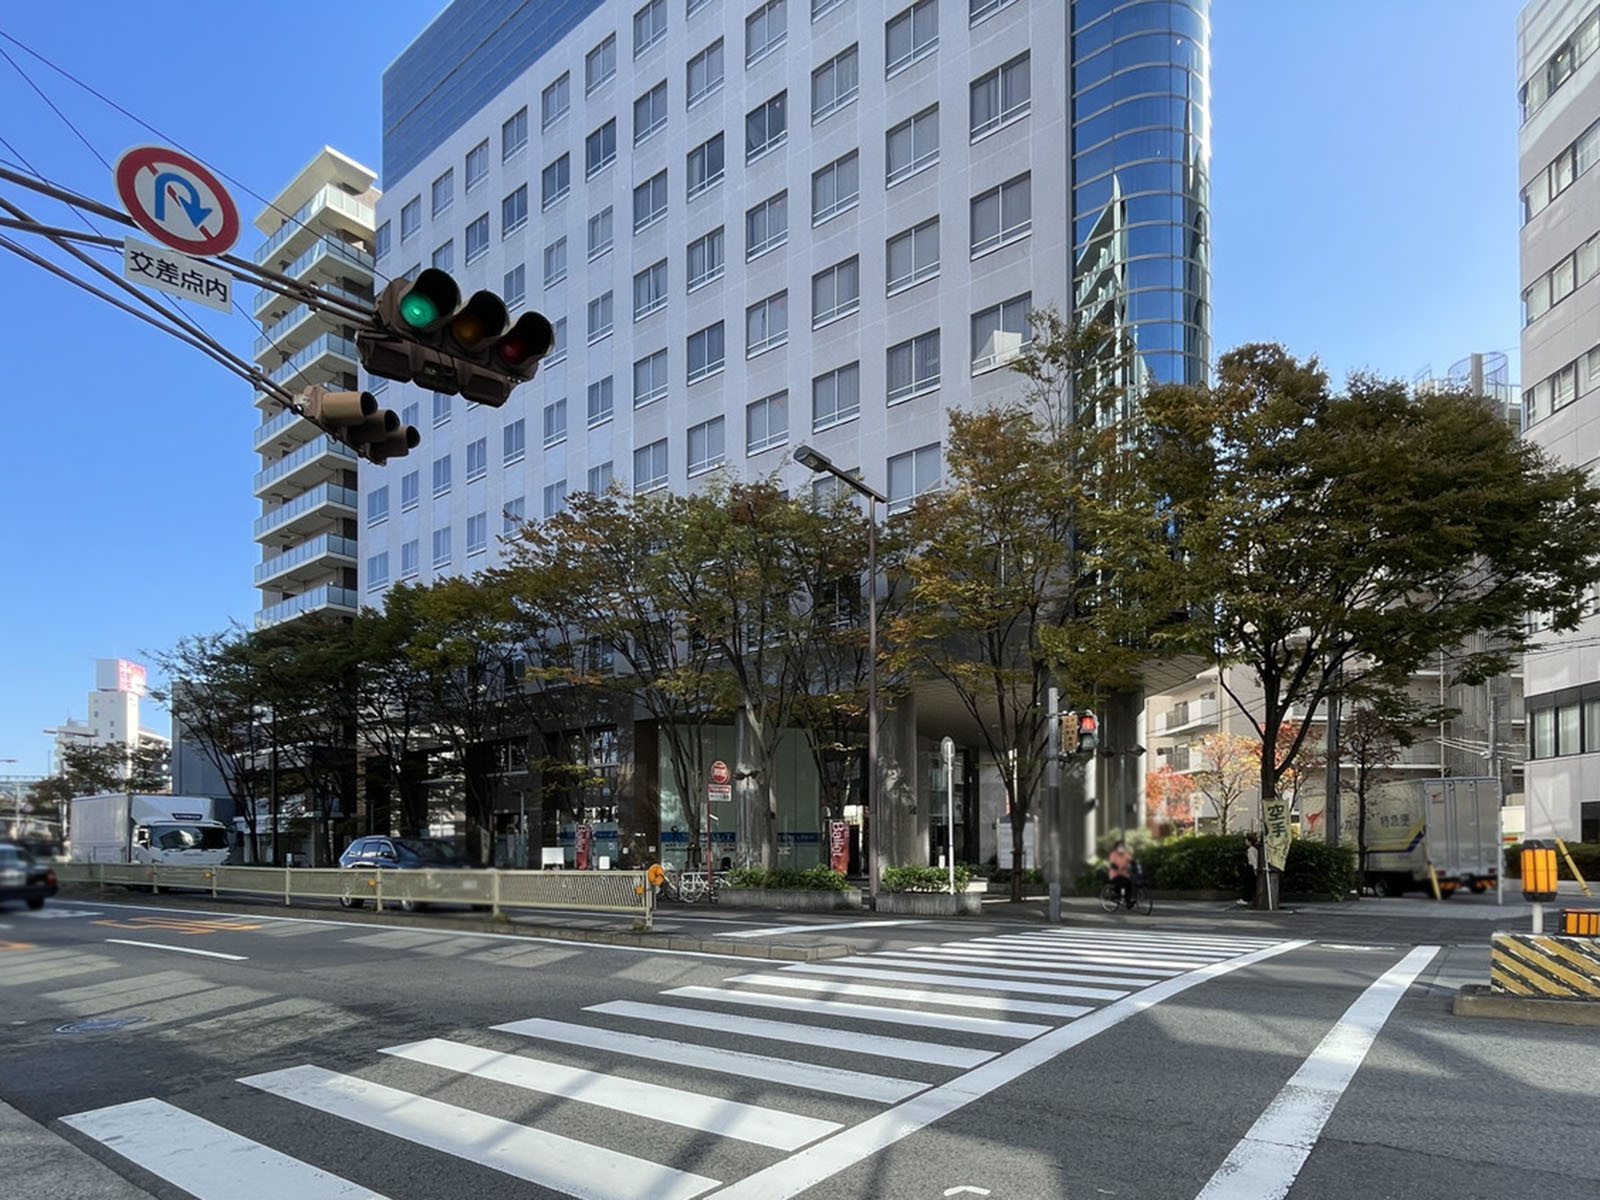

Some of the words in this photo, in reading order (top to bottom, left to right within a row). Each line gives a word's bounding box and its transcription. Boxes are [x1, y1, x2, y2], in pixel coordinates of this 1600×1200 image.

[129, 250, 228, 303] 交差点内
[1267, 804, 1286, 838] 空手
